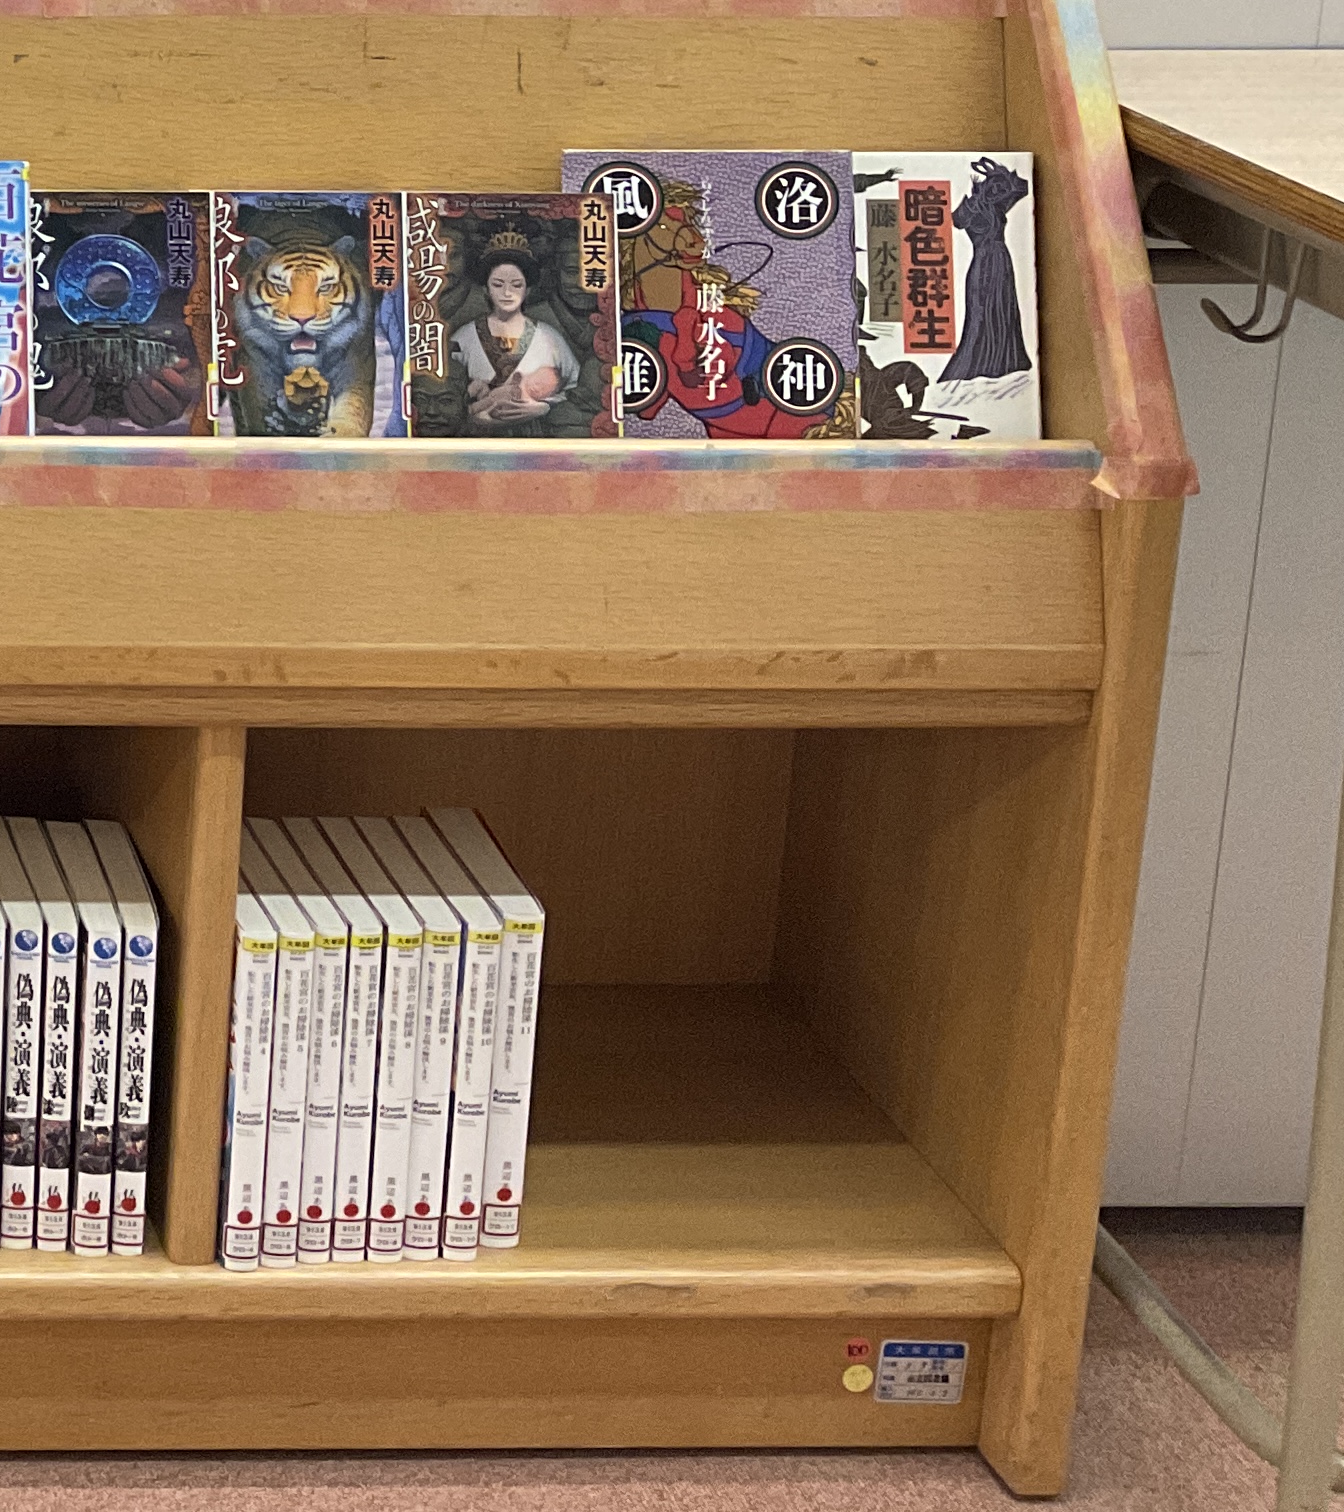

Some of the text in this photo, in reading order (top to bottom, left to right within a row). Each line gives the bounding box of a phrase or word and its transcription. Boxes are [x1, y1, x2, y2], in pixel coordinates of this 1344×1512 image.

[603, 175, 650, 220] 風
[775, 176, 821, 224] 洛
[166, 198, 192, 288] 丸山天寿
[372, 198, 396, 288] 丸山天寿
[583, 199, 609, 290] 丸山天寿
[869, 201, 899, 320] 藤水名子
[904, 186, 954, 352] 暗色群生
[696, 284, 728, 401] 藤水名子
[775, 352, 826, 401] 神
